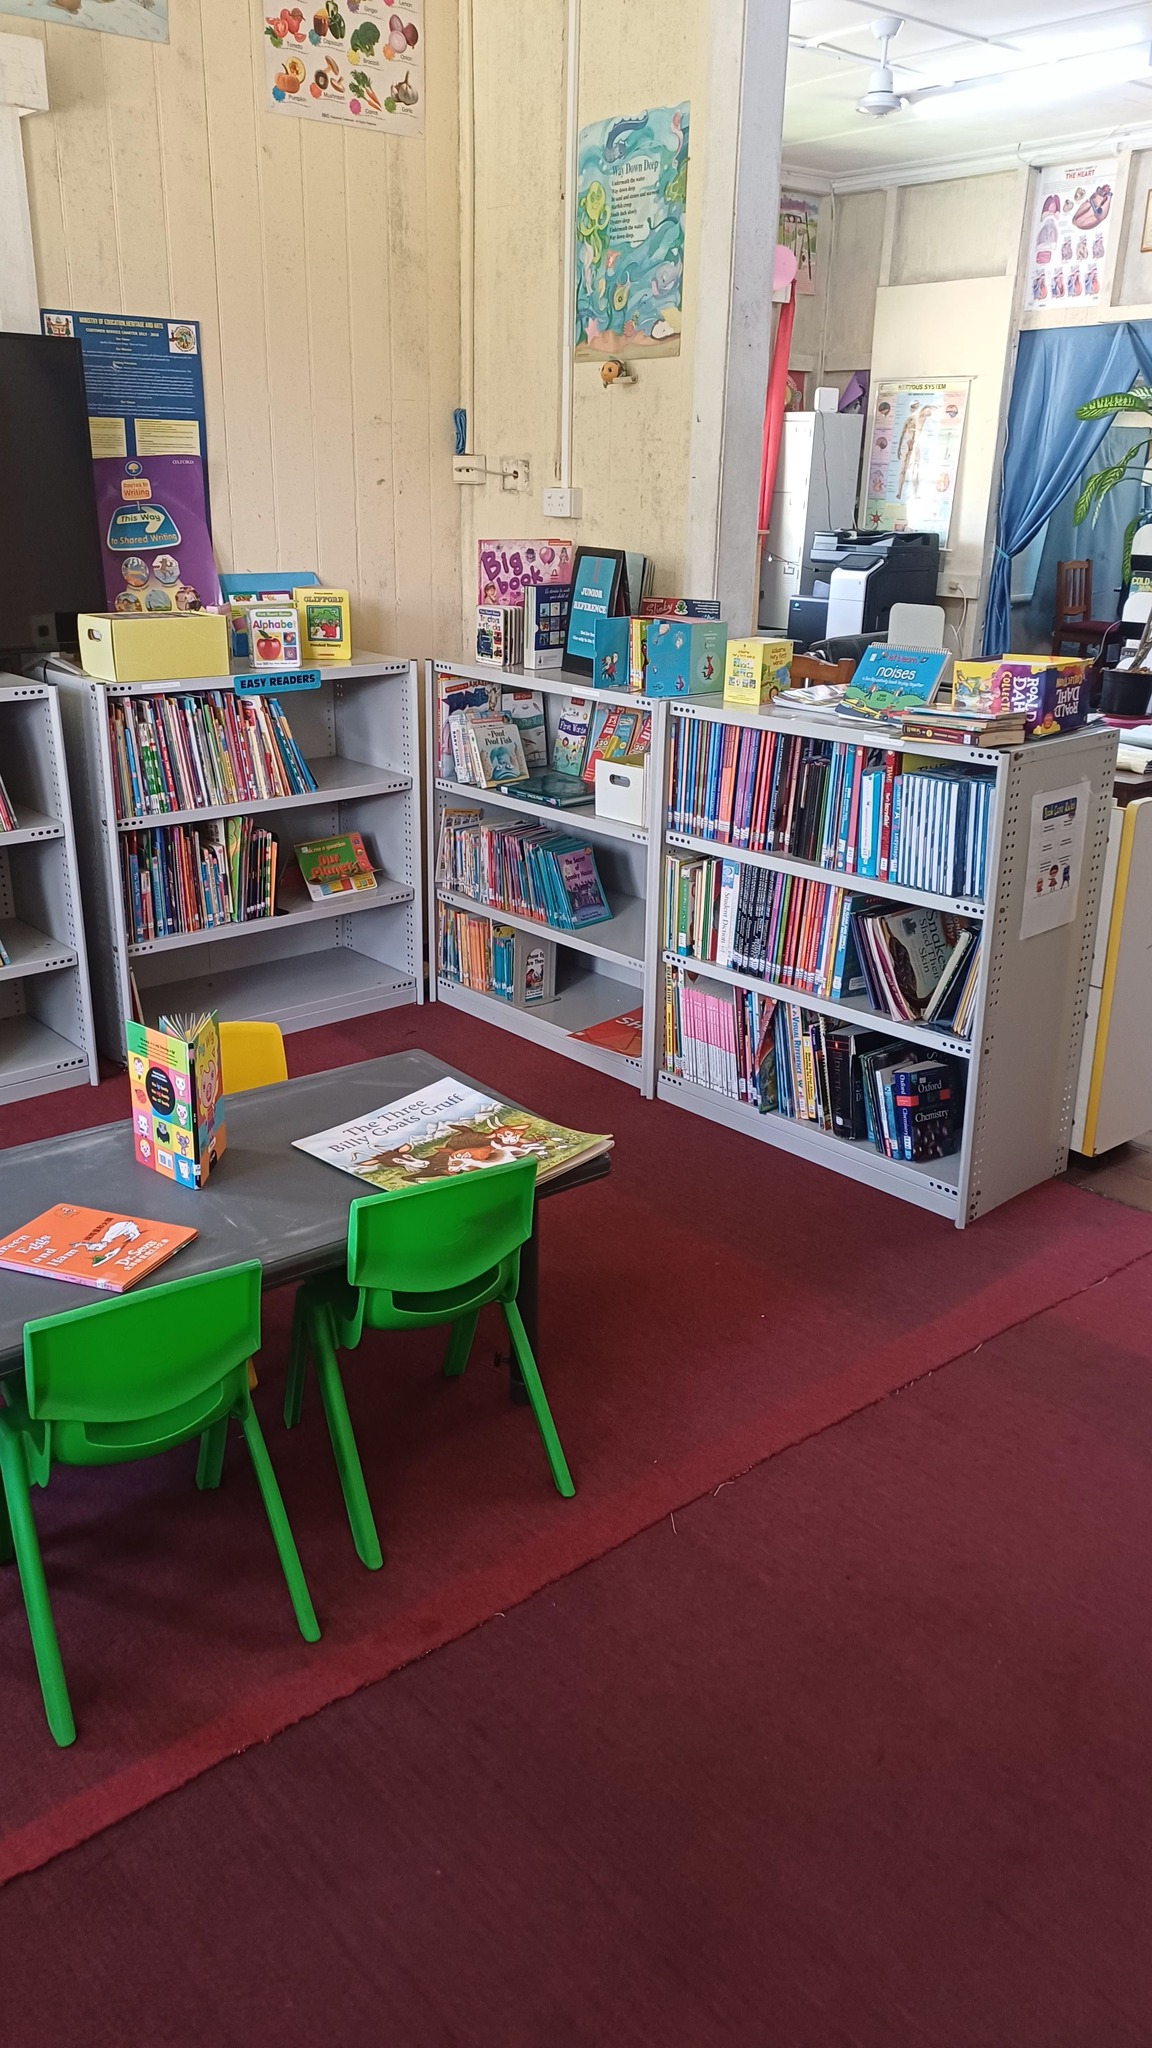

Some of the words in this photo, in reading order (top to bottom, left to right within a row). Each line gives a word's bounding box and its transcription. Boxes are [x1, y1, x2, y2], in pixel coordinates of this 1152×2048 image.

[287, 40, 304, 50] Tomato
[323, 38, 344, 48] Capsicum
[400, 54, 413, 62] Onion
[288, 94, 307, 103] Pumpkin
[323, 92, 346, 101] Mushroom
[401, 106, 413, 114] Garlic
[612, 165, 624, 178] Way
[625, 162, 643, 175] Down
[643, 159, 659, 173] Deep
[1077, 169, 1096, 178] HEART
[123, 488, 150, 498] Writing
[120, 514, 138, 523] This
[141, 513, 162, 523] Way
[111, 537, 118, 545] to
[119, 534, 148, 545] Shared
[150, 532, 178, 543] Writing
[481, 551, 524, 581] Big
[497, 564, 544, 595] book
[1132, 576, 1150, 585] COLD
[581, 587, 603, 599] JUNIOR
[573, 600, 607, 615] REFERENCE
[646, 600, 673, 615] Slinky
[252, 620, 297, 630] Alphabet
[875, 665, 917, 680] noises
[240, 678, 266, 690] EASY
[269, 674, 316, 686] READERS
[1000, 671, 1012, 711] COLLECTI
[1012, 676, 1027, 712] DAH
[1056, 685, 1081, 704] DAHL
[1025, 677, 1040, 722] ROALD
[1054, 701, 1079, 718] ROALD
[326, 842, 346, 850] question
[318, 854, 339, 866] Our
[311, 862, 352, 878] Planet
[723, 892, 731, 917] Student
[720, 919, 729, 945] Diction
[919, 918, 932, 945] Shed
[927, 946, 942, 979] Their
[926, 909, 947, 972] Snakes
[527, 952, 539, 960] hose
[918, 946, 930, 973] Skin
[616, 1016, 643, 1031] SH
[792, 1016, 800, 1039] VISUAL
[794, 1040, 802, 1074] REFERENCE
[917, 1080, 943, 1094] Oxford
[328, 1135, 370, 1153] Billy
[372, 1115, 421, 1137] Goats
[420, 1093, 464, 1116] Gruff
[343, 1120, 379, 1137] The
[377, 1099, 428, 1122] Three
[914, 1108, 949, 1123] Chemistry
[15, 1234, 52, 1255] Eggs
[31, 1248, 57, 1265] and
[47, 1248, 79, 1267] Ham
[114, 1252, 135, 1267] Dr.
[130, 1239, 159, 1258] Seuss
